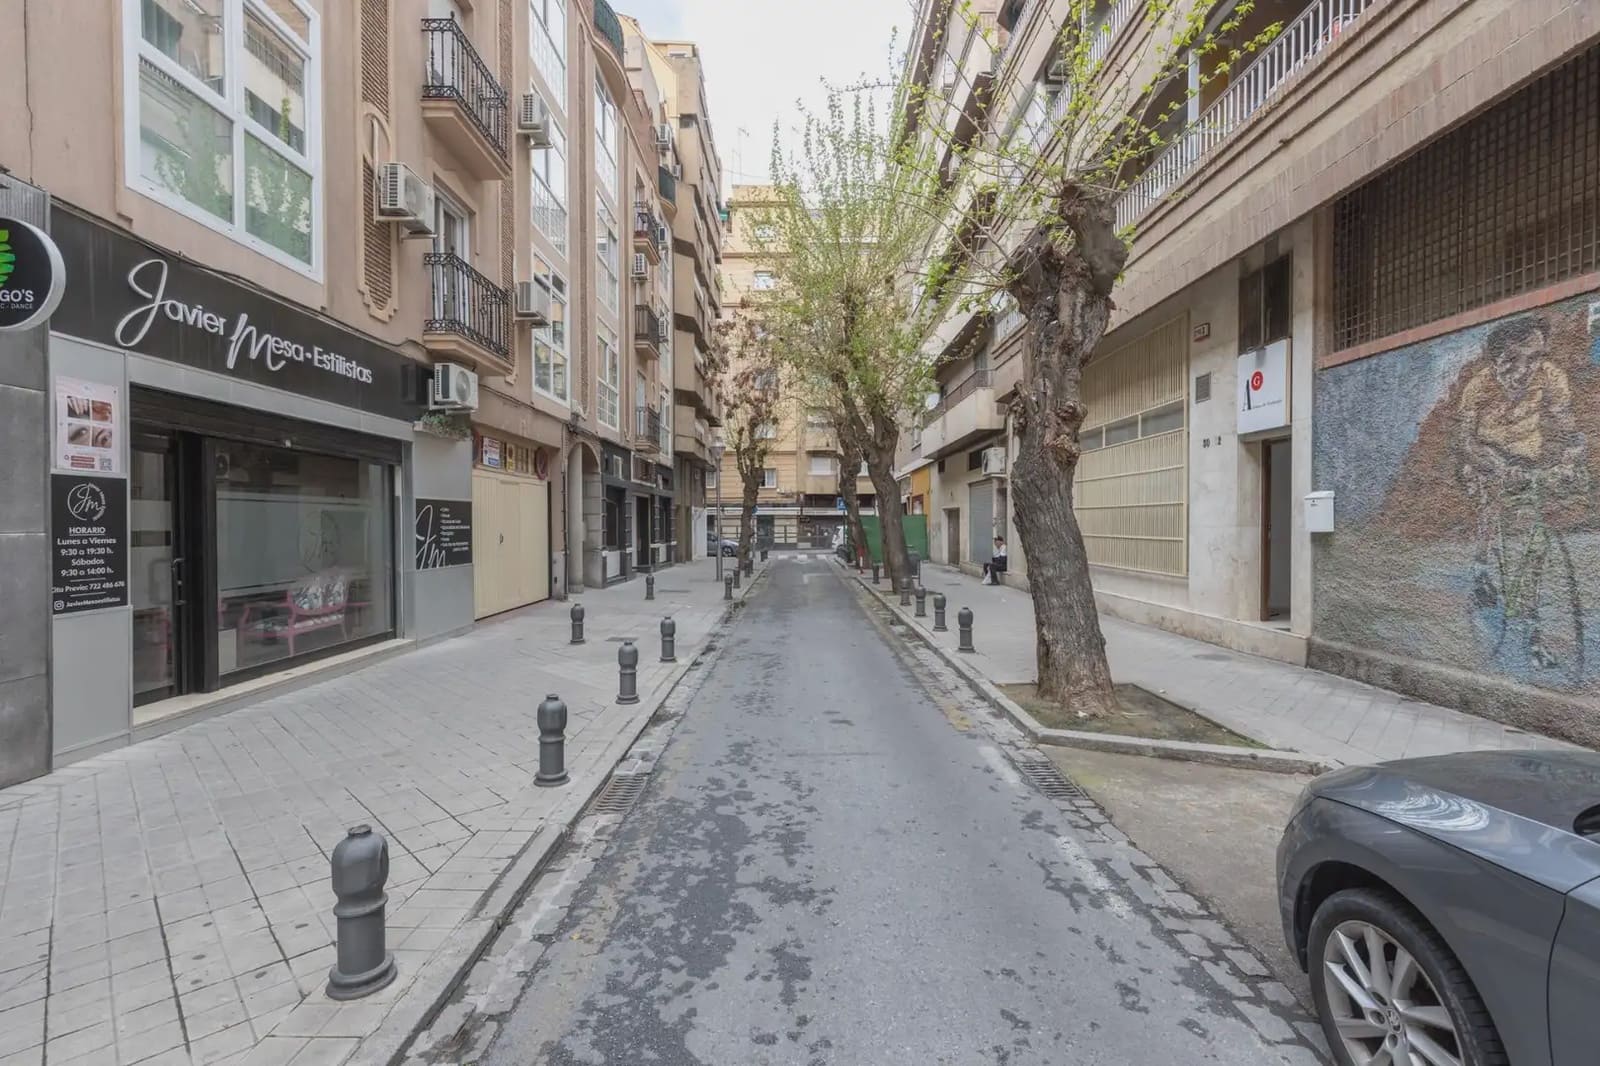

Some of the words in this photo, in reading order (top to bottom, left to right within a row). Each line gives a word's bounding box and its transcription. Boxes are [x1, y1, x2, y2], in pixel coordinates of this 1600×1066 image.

[10, 302, 33, 310] DANCE
[115, 259, 227, 347] Javier
[226, 312, 304, 372] Mesa
[313, 345, 373, 384] Estilistas
[68, 526, 106, 534] HORARIO
[60, 548, 78, 556] 9:30
[86, 547, 106, 555] 19:30
[71, 557, 105, 566] Sábados
[60, 568, 78, 577] 9:30
[87, 567, 106, 575] 14:00
